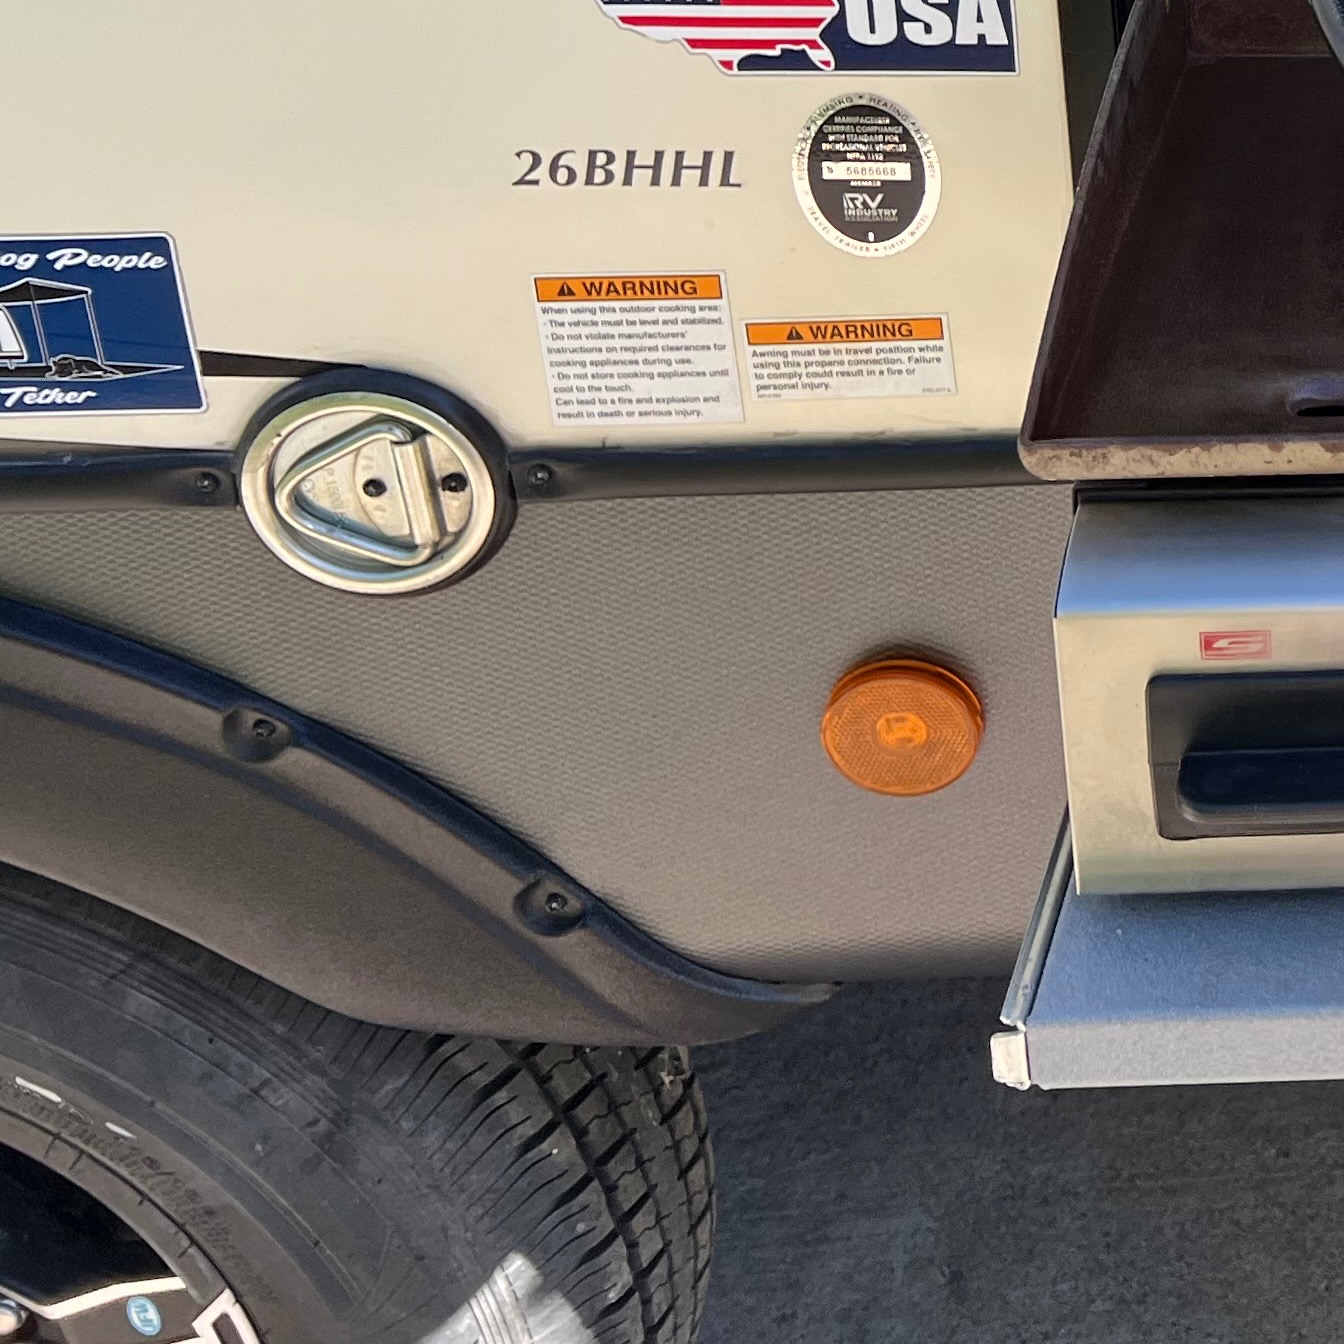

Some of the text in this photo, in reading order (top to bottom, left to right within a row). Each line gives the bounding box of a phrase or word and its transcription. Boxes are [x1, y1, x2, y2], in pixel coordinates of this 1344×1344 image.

[511, 148, 743, 188] 26BHHL
[0, 248, 167, 272] og People
[582, 279, 698, 297] WARNING
[541, 306, 567, 315] When
[571, 307, 597, 315] using
[600, 306, 616, 314] this
[619, 305, 655, 314] outdoor
[658, 305, 696, 314] cooking
[549, 319, 565, 328] The
[568, 319, 599, 327] vehicle
[601, 319, 623, 327] must
[626, 318, 637, 326] be
[639, 318, 659, 326] level
[662, 318, 678, 326] and
[551, 332, 564, 341] Do
[585, 332, 615, 340] violate
[808, 322, 913, 340] WARNING
[620, 344, 659, 354] required
[661, 344, 711, 352] clearances
[713, 343, 726, 351] for
[752, 349, 788, 359] Awning
[791, 348, 816, 357] must
[819, 348, 831, 356] be
[845, 346, 873, 355] travel
[876, 345, 916, 355] position
[918, 344, 944, 353] while
[550, 359, 587, 368] cooking
[589, 358, 639, 368] appliances
[642, 357, 672, 367] during
[753, 361, 781, 370] using
[783, 360, 801, 368] this
[804, 360, 845, 369] propane
[907, 355, 942, 364] Failure
[557, 372, 570, 380] Do
[573, 372, 589, 380] not
[617, 370, 654, 380] cooking
[657, 370, 706, 380] appliances
[709, 368, 729, 377] until
[755, 372, 765, 380] to
[767, 371, 803, 381] comply
[805, 370, 833, 378] could
[836, 369, 864, 377] result
[867, 368, 876, 376] in
[887, 367, 903, 375] fire
[554, 385, 574, 393] cool
[576, 385, 585, 393] to
[588, 384, 602, 393] the
[756, 381, 832, 393] personal injury.
[0, 387, 98, 407] Tether
[556, 398, 574, 406] Can
[576, 397, 595, 406] lead
[618, 396, 633, 405] fire
[636, 396, 653, 404] and
[656, 395, 700, 405] explosion
[703, 395, 720, 403] and
[557, 411, 584, 419] result
[598, 410, 623, 418] death
[638, 409, 672, 417] serious
